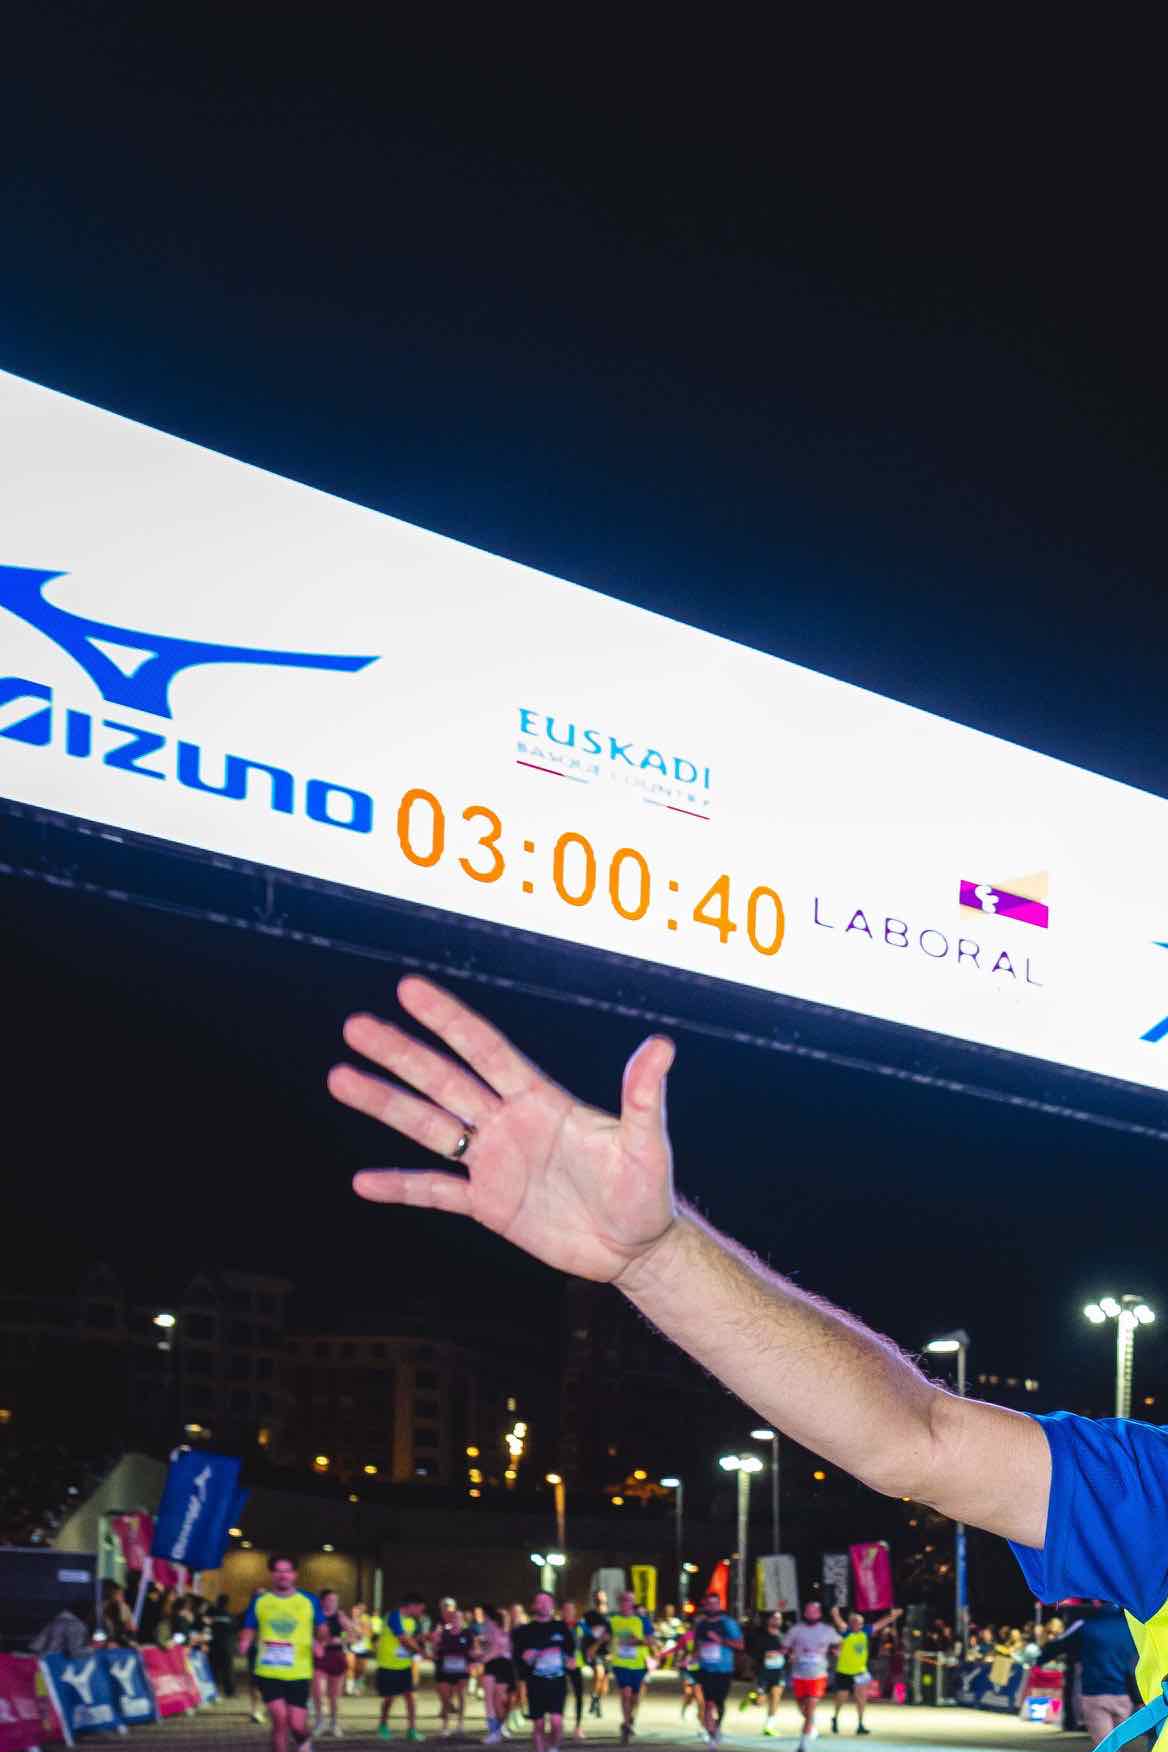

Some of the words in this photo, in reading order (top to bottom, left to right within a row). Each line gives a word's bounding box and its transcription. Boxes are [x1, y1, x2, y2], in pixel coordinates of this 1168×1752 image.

[518, 707, 711, 790] EUSKADI
[397, 788, 785, 957] 03:00:40
[813, 896, 1044, 987] LABORAL
